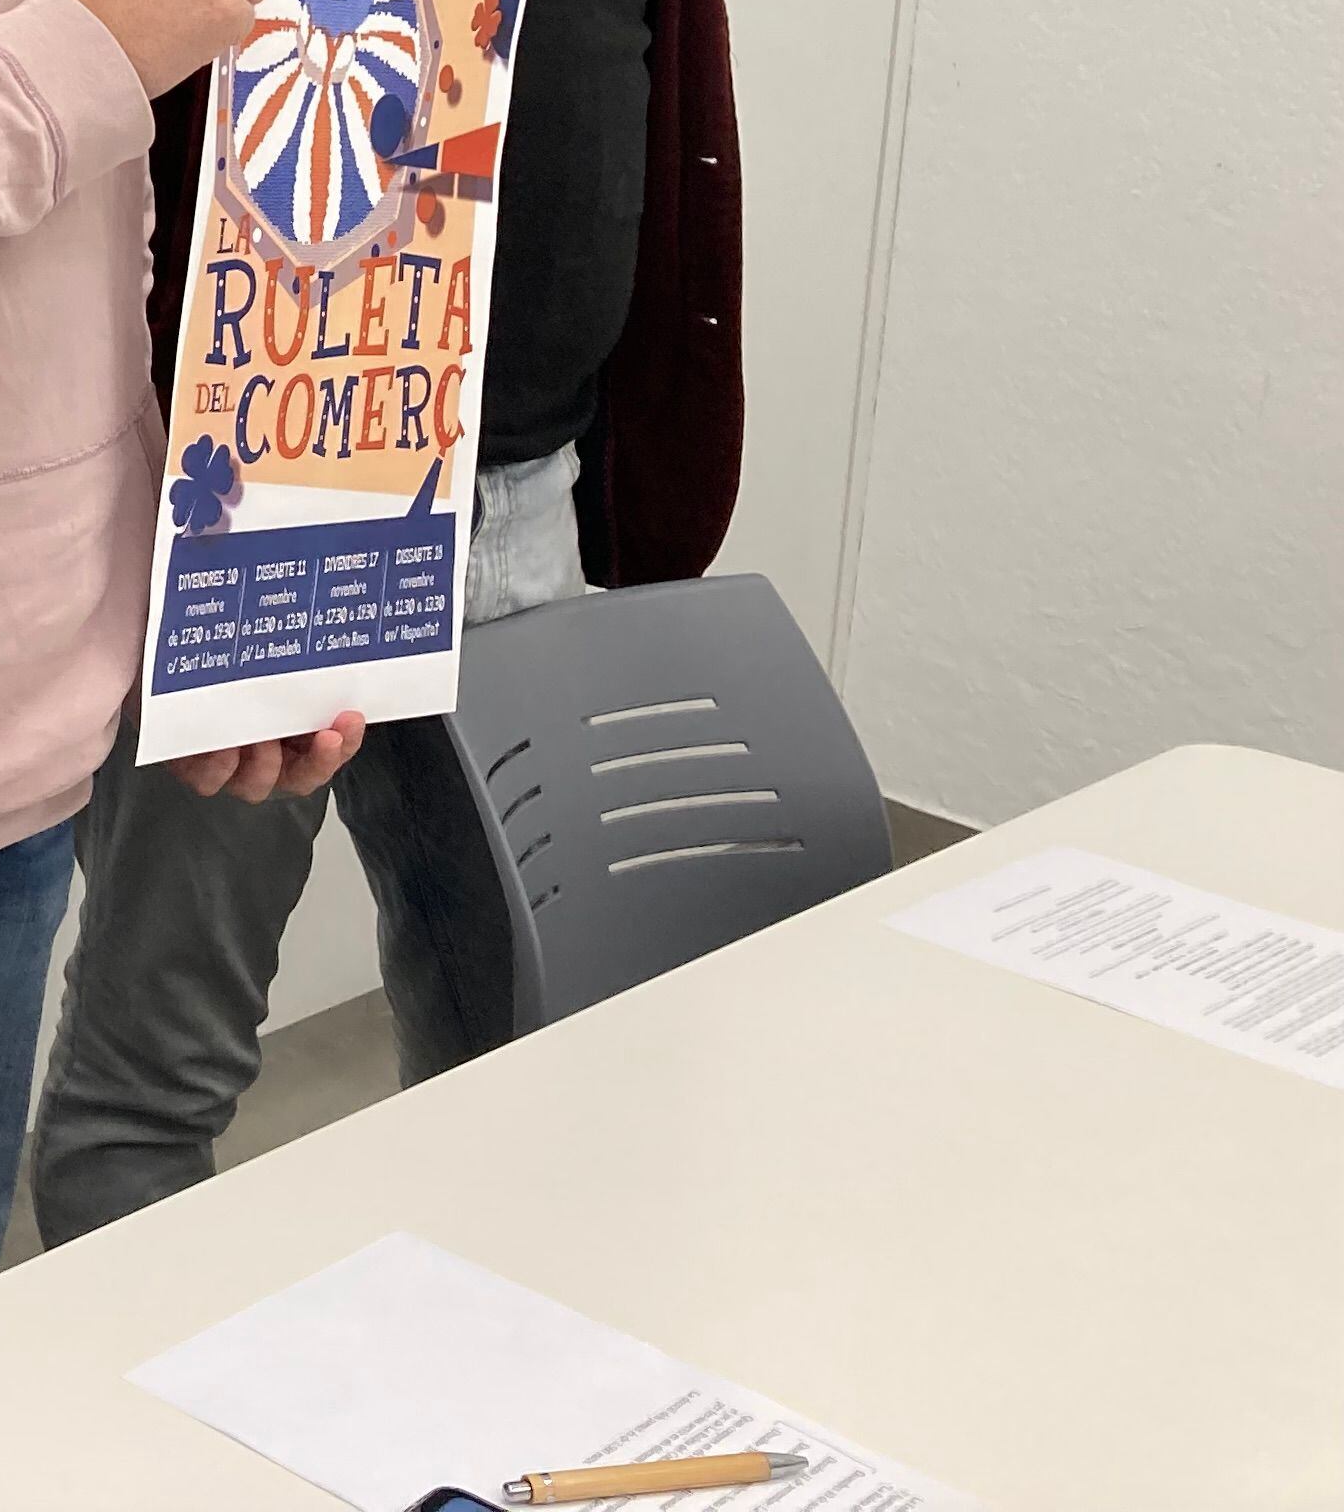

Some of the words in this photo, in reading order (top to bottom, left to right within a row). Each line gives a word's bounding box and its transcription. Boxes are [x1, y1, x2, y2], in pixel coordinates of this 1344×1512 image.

[216, 212, 251, 255] LA
[204, 252, 473, 370] RULETA
[194, 381, 236, 414] DEL
[235, 363, 467, 465] COMERÇ
